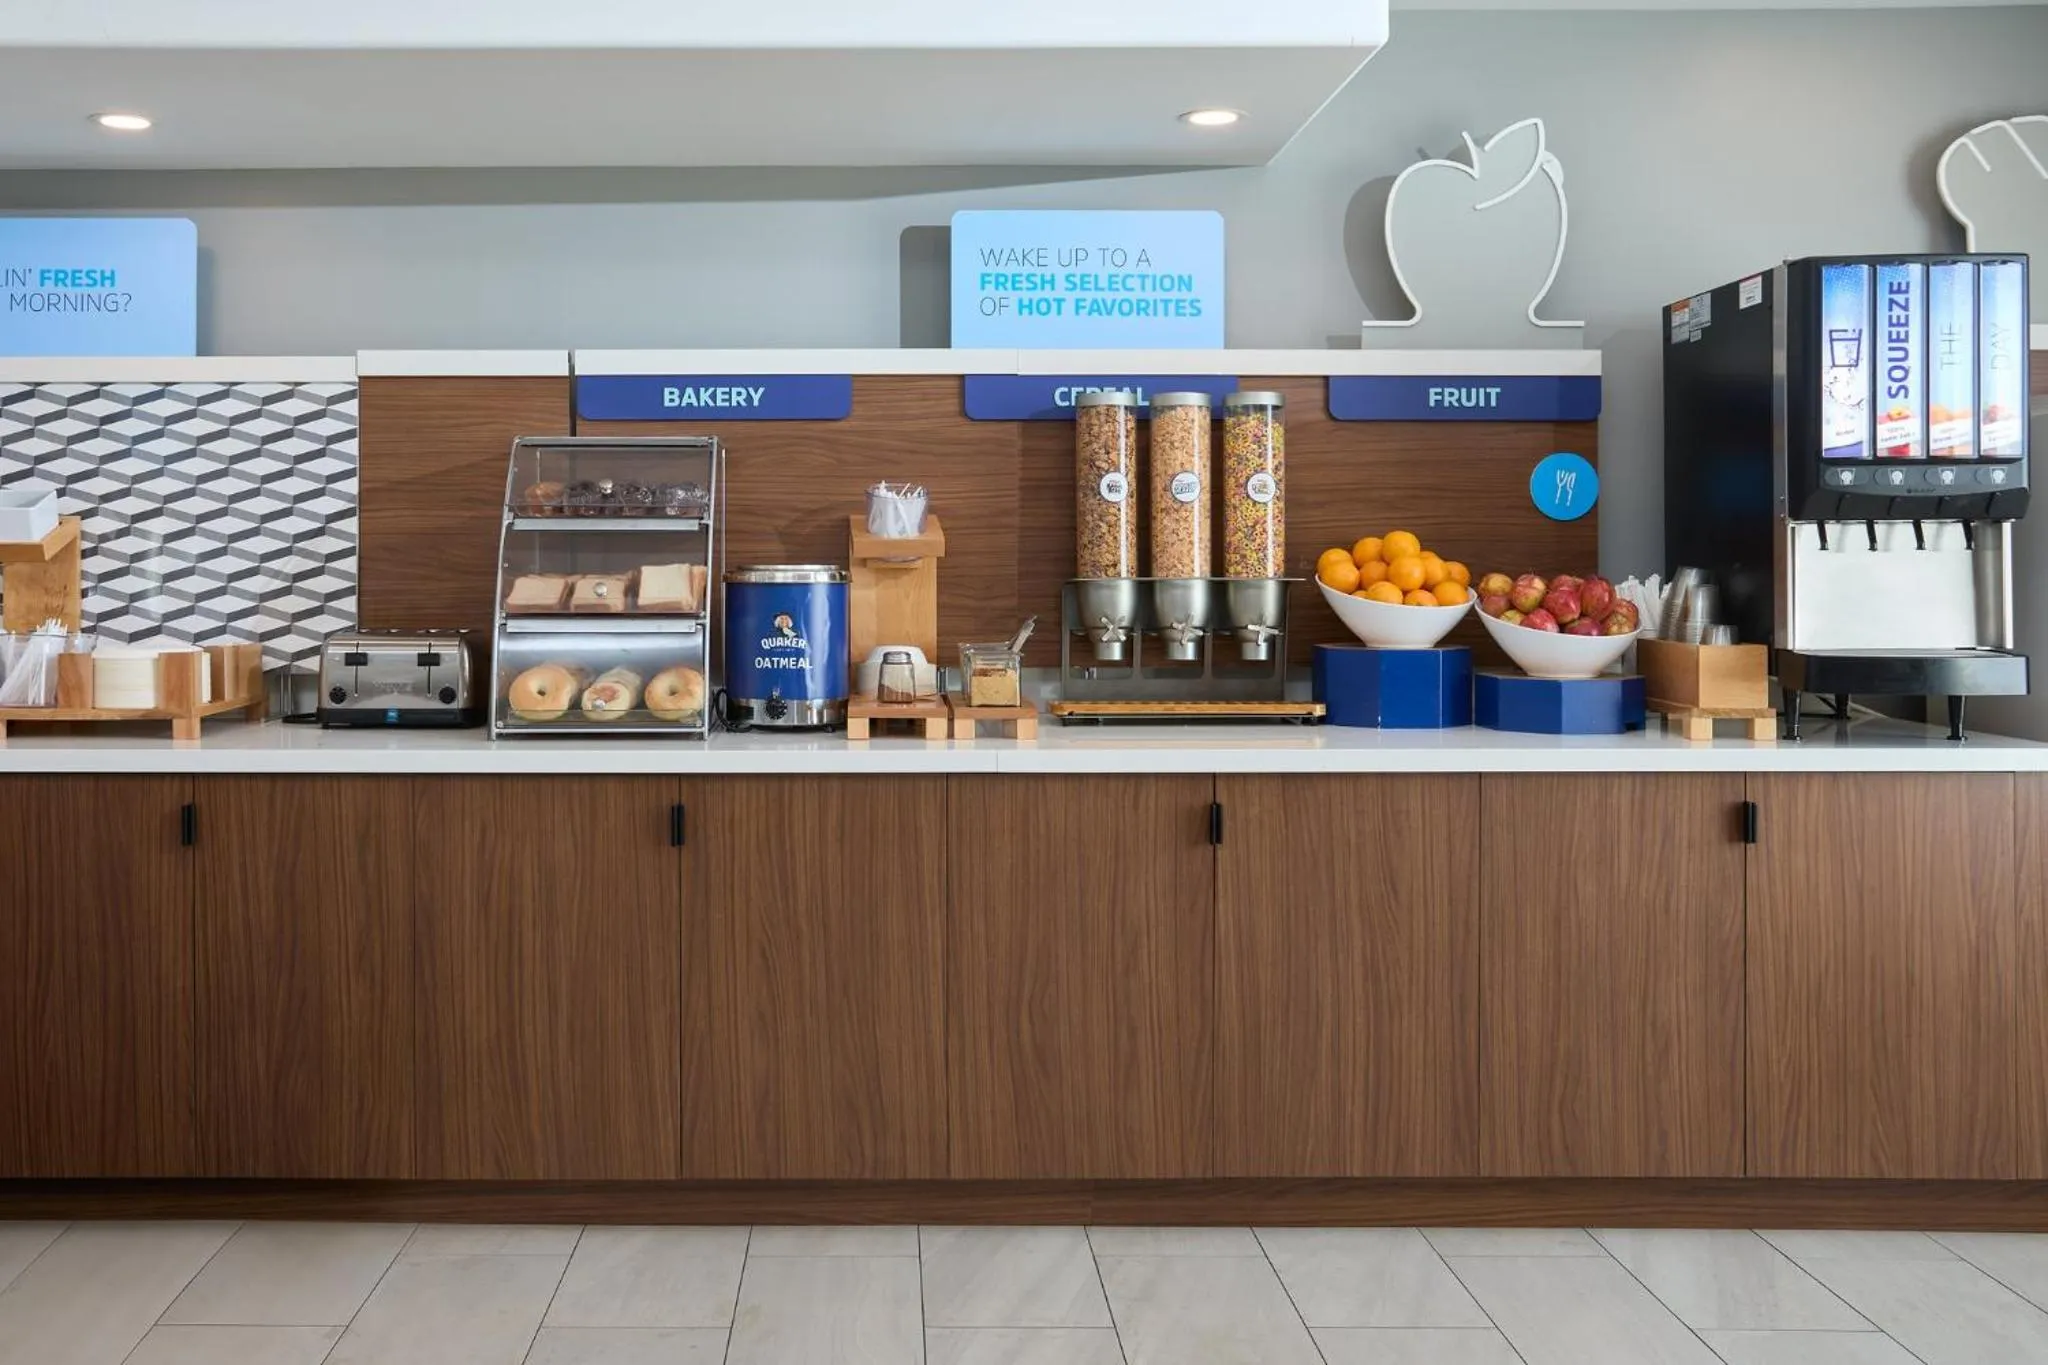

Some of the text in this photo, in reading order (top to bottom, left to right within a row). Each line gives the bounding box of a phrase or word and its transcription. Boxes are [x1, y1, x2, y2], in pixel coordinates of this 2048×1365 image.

[979, 247, 1152, 268] WAKE UP TO A
[39, 268, 116, 288] FRESH
[979, 272, 1193, 292] FRESH SELECTION
[10, 292, 132, 312] MORNING?
[979, 296, 1202, 317] OF HOT FAVORITES
[1887, 281, 1910, 399] SQUEEZE
[1940, 320, 1962, 371] THE
[1991, 322, 2011, 370] DAY
[663, 387, 766, 407] BAKERY
[1428, 387, 1501, 408] FRUIT
[761, 637, 808, 649] QUAKER
[755, 657, 813, 669] OATMEAL
